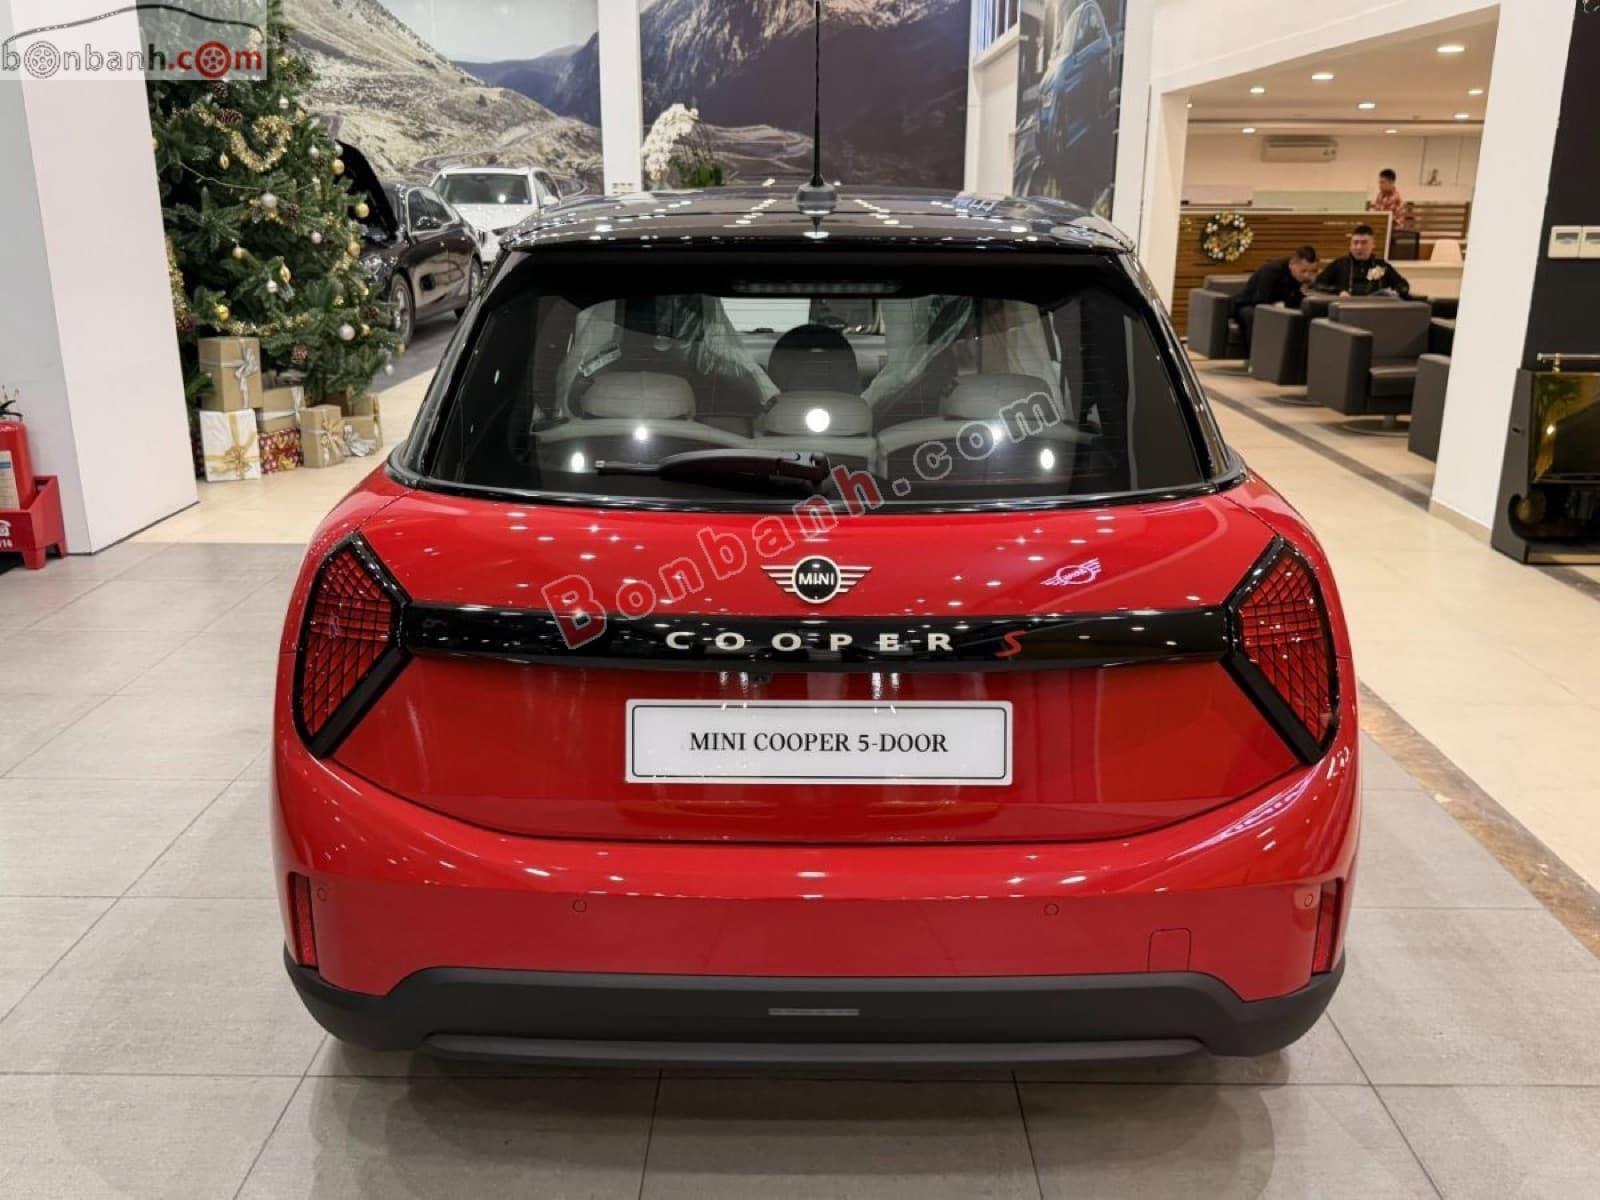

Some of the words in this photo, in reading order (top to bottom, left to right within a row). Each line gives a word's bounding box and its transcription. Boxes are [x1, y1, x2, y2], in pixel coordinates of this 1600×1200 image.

[798, 572, 836, 586] MINI
[665, 632, 954, 652] COOPER
[995, 629, 1026, 658] S
[689, 732, 746, 752] MINI
[753, 732, 851, 753] COOPER
[857, 733, 949, 754] 5-DOOR
